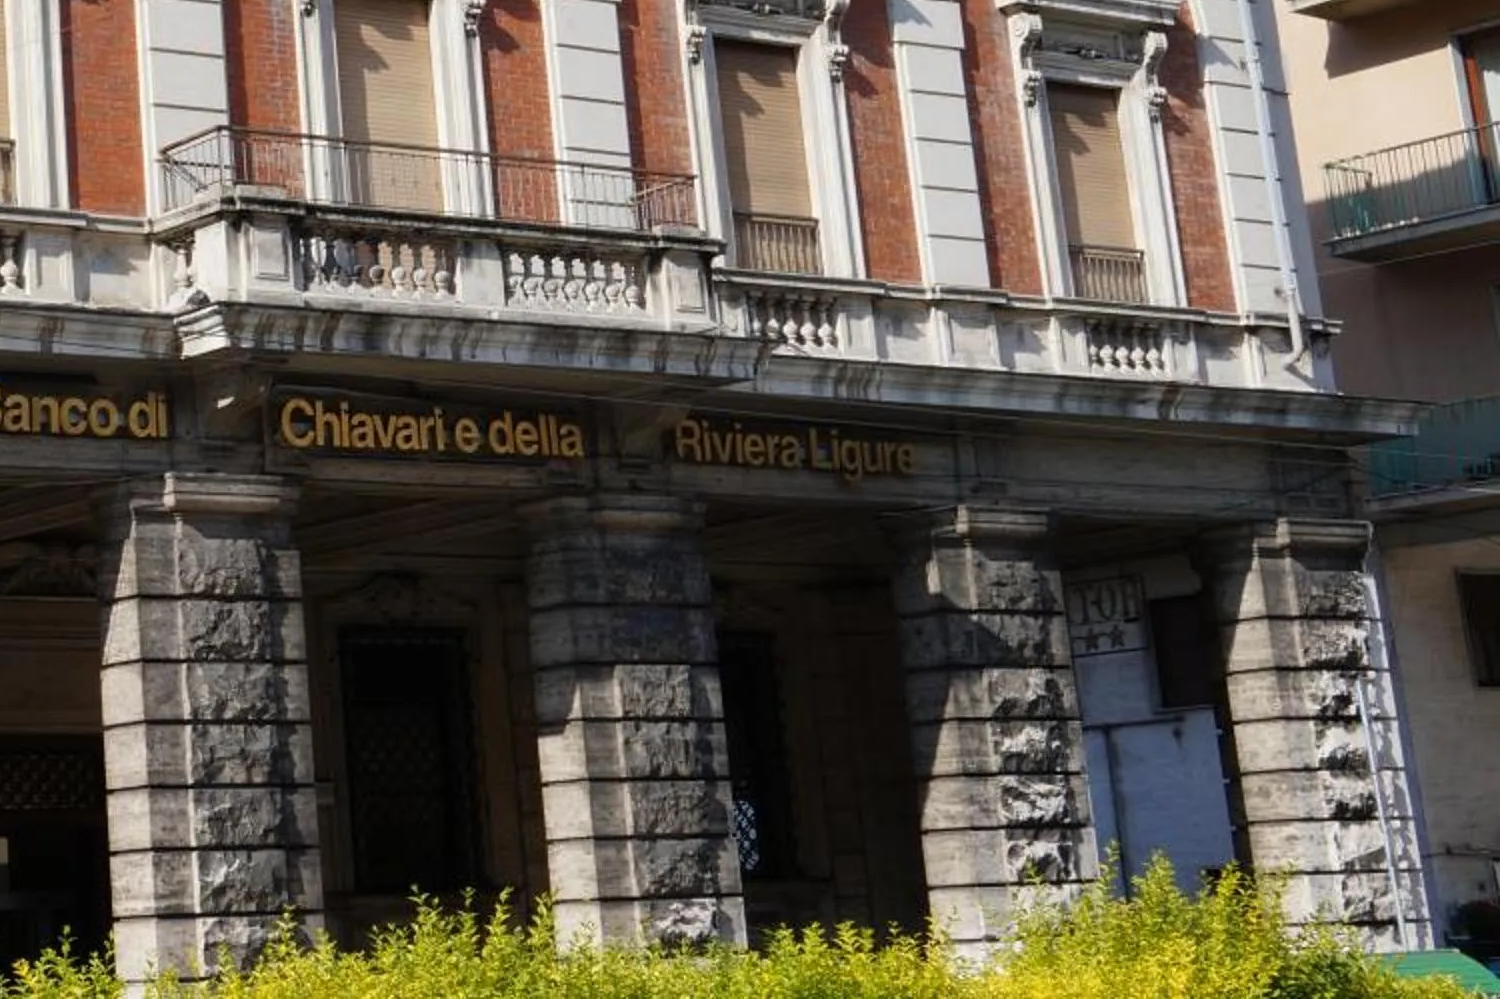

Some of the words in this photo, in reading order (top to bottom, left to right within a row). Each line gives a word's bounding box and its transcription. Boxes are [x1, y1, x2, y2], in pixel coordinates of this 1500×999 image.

[127, 390, 169, 439] di
[280, 397, 446, 452] Chiavari
[454, 416, 481, 454] e
[488, 408, 585, 458] della
[675, 419, 801, 469] Riviera
[808, 427, 916, 482] Ligure
